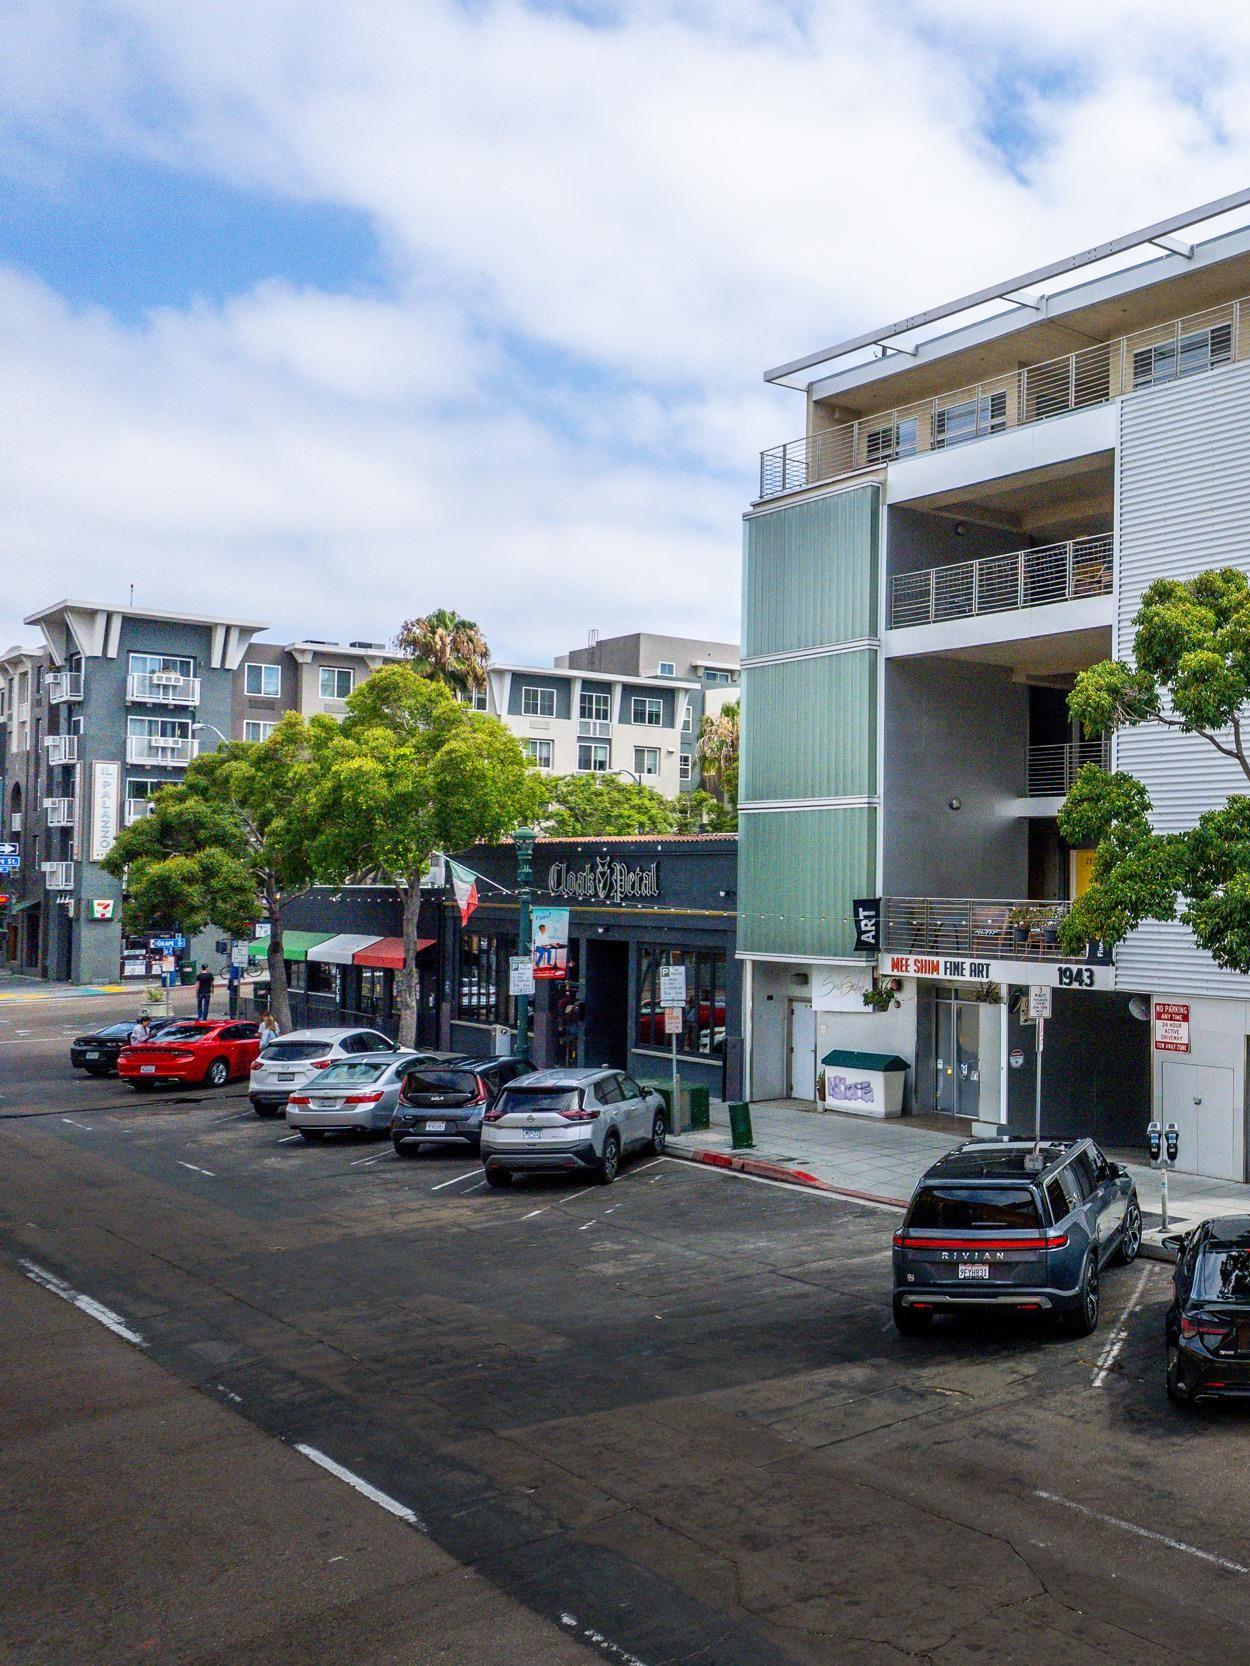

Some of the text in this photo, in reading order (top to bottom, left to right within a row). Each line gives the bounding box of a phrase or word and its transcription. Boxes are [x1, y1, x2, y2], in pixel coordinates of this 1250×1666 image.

[100, 781, 112, 848] PALAZZO
[548, 862, 659, 902] Cloak Petal
[859, 908, 876, 944] ART
[662, 968, 669, 976] P
[891, 957, 992, 979] MEE SHIM FINE ART
[1057, 966, 1095, 987] 1943
[1164, 1005, 1187, 1015] PARKING
[941, 1252, 1004, 1260] RIVIAN
